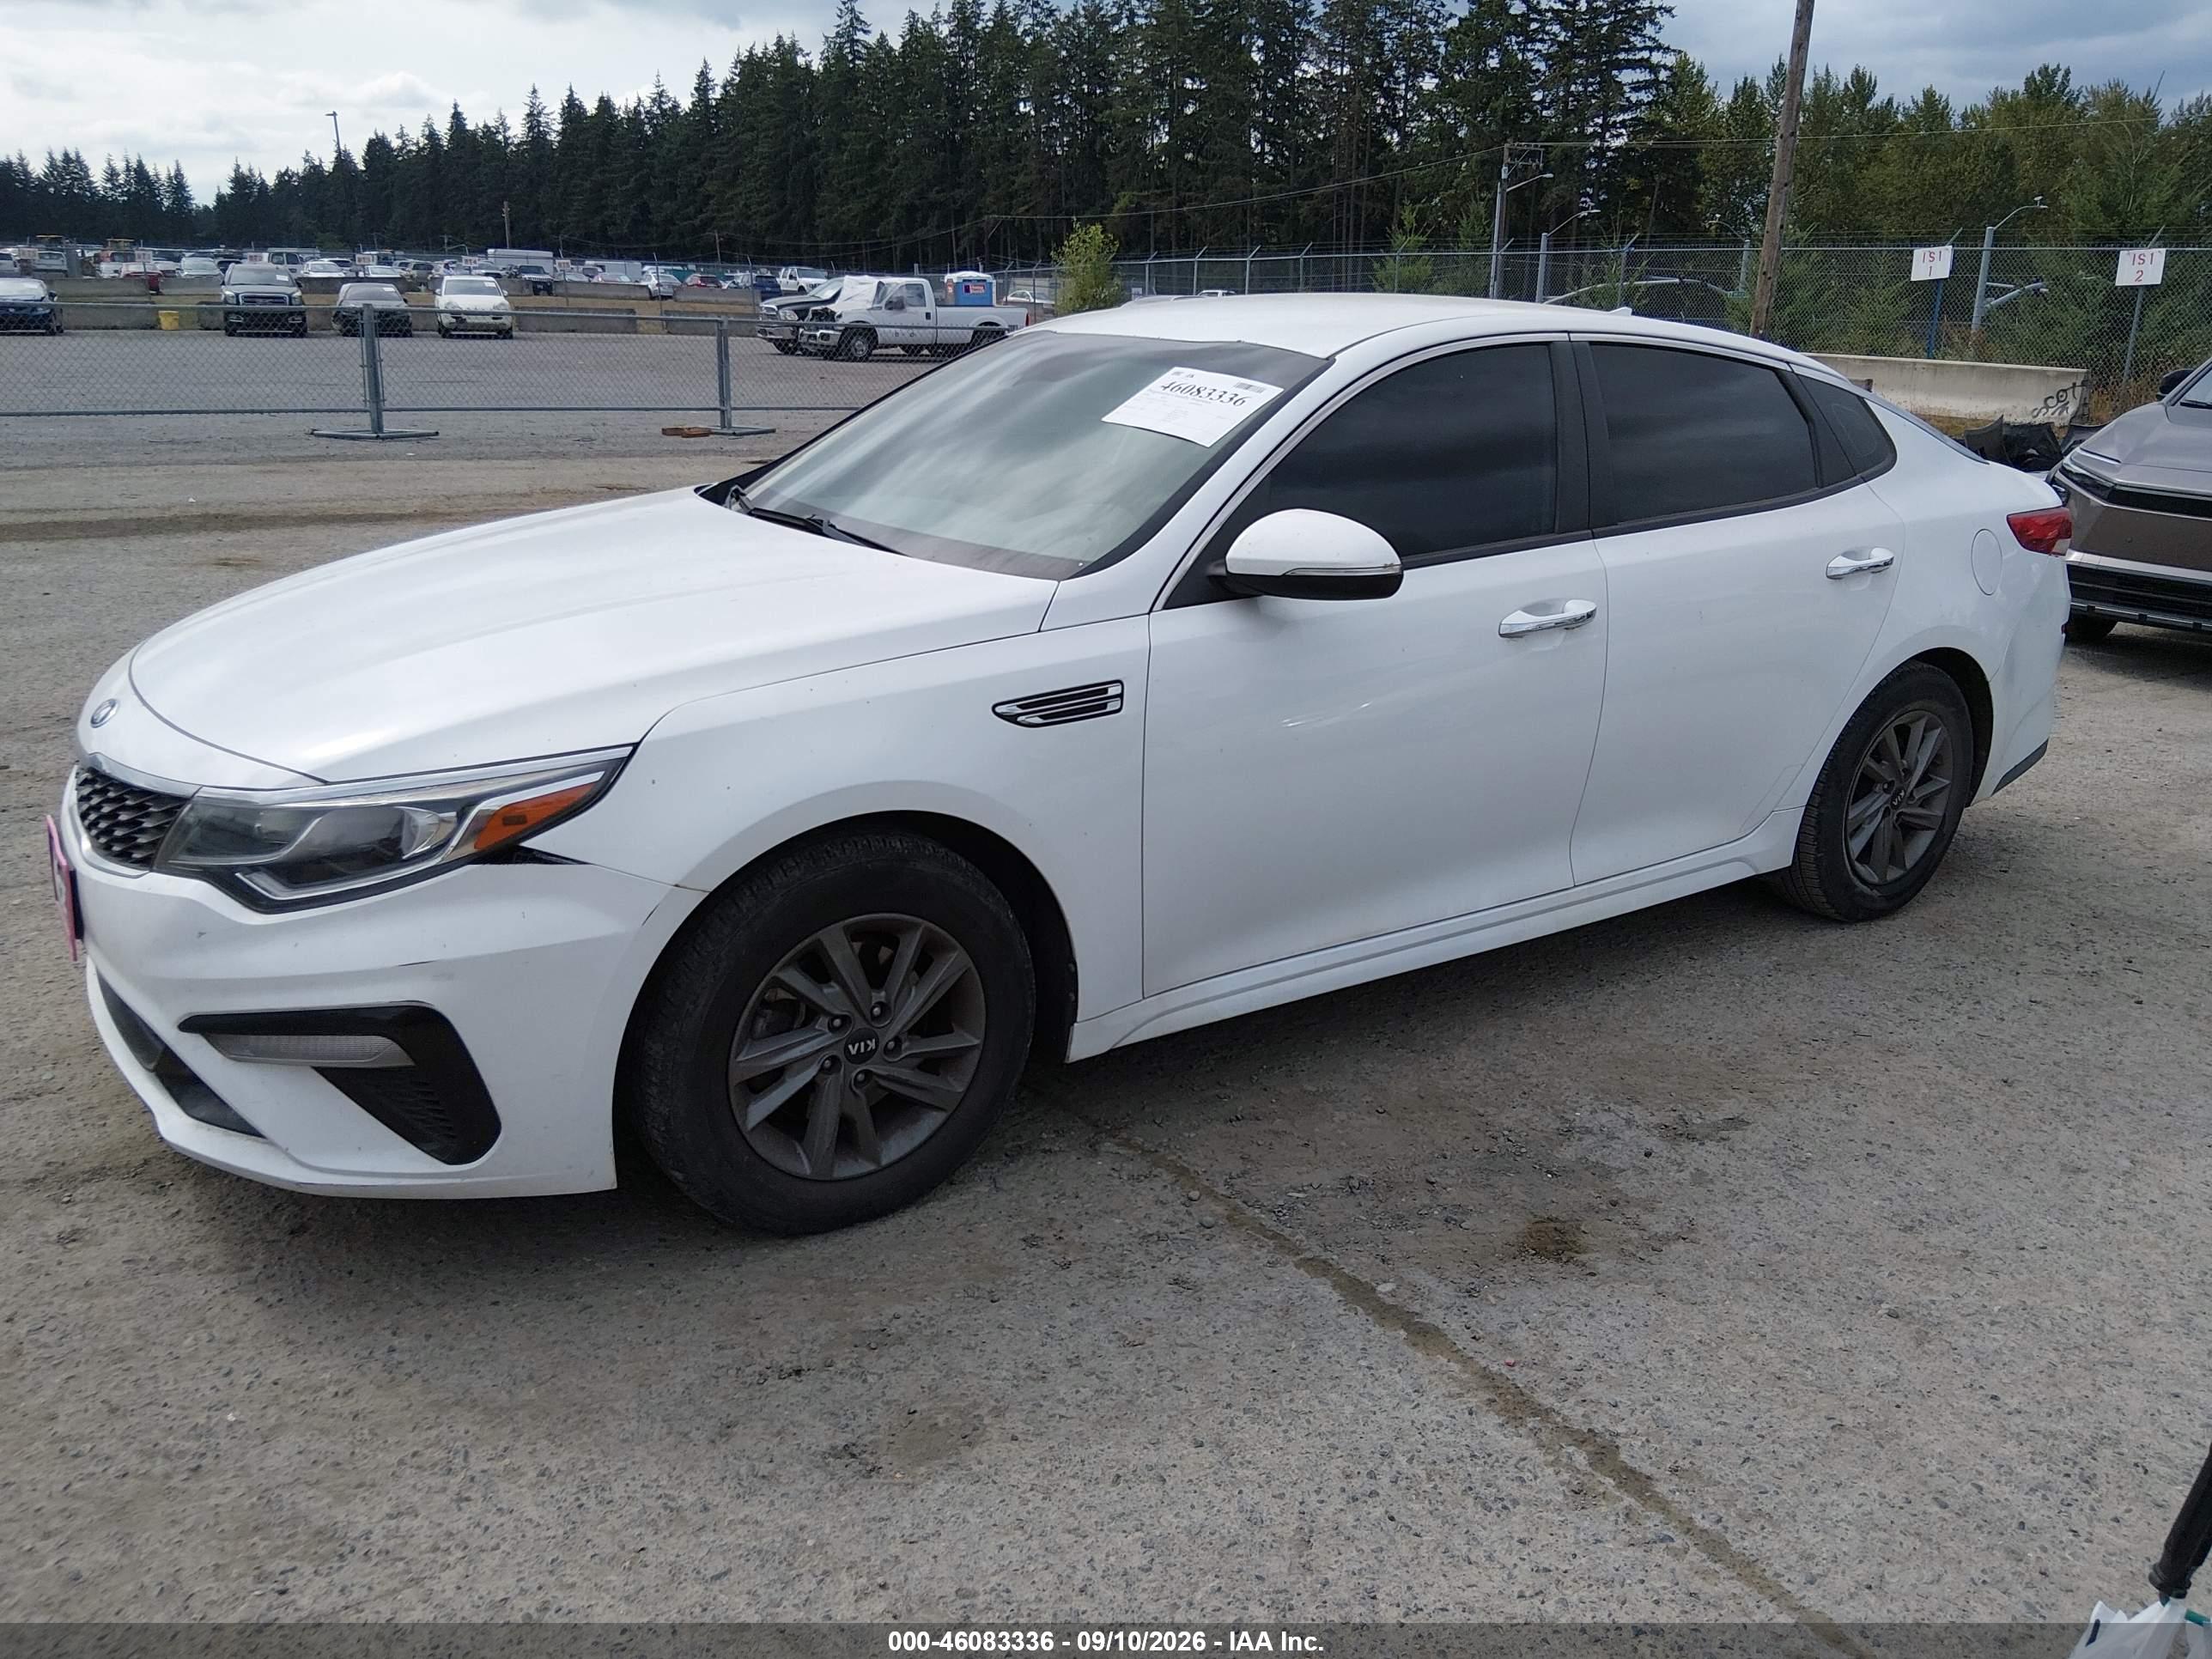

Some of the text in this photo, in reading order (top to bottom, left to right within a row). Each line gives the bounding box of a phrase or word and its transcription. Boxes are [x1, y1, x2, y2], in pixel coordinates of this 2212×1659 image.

[2135, 270, 2144, 283] 2
[1161, 380, 1252, 407] 46083336
[848, 1037, 876, 1055] KIA
